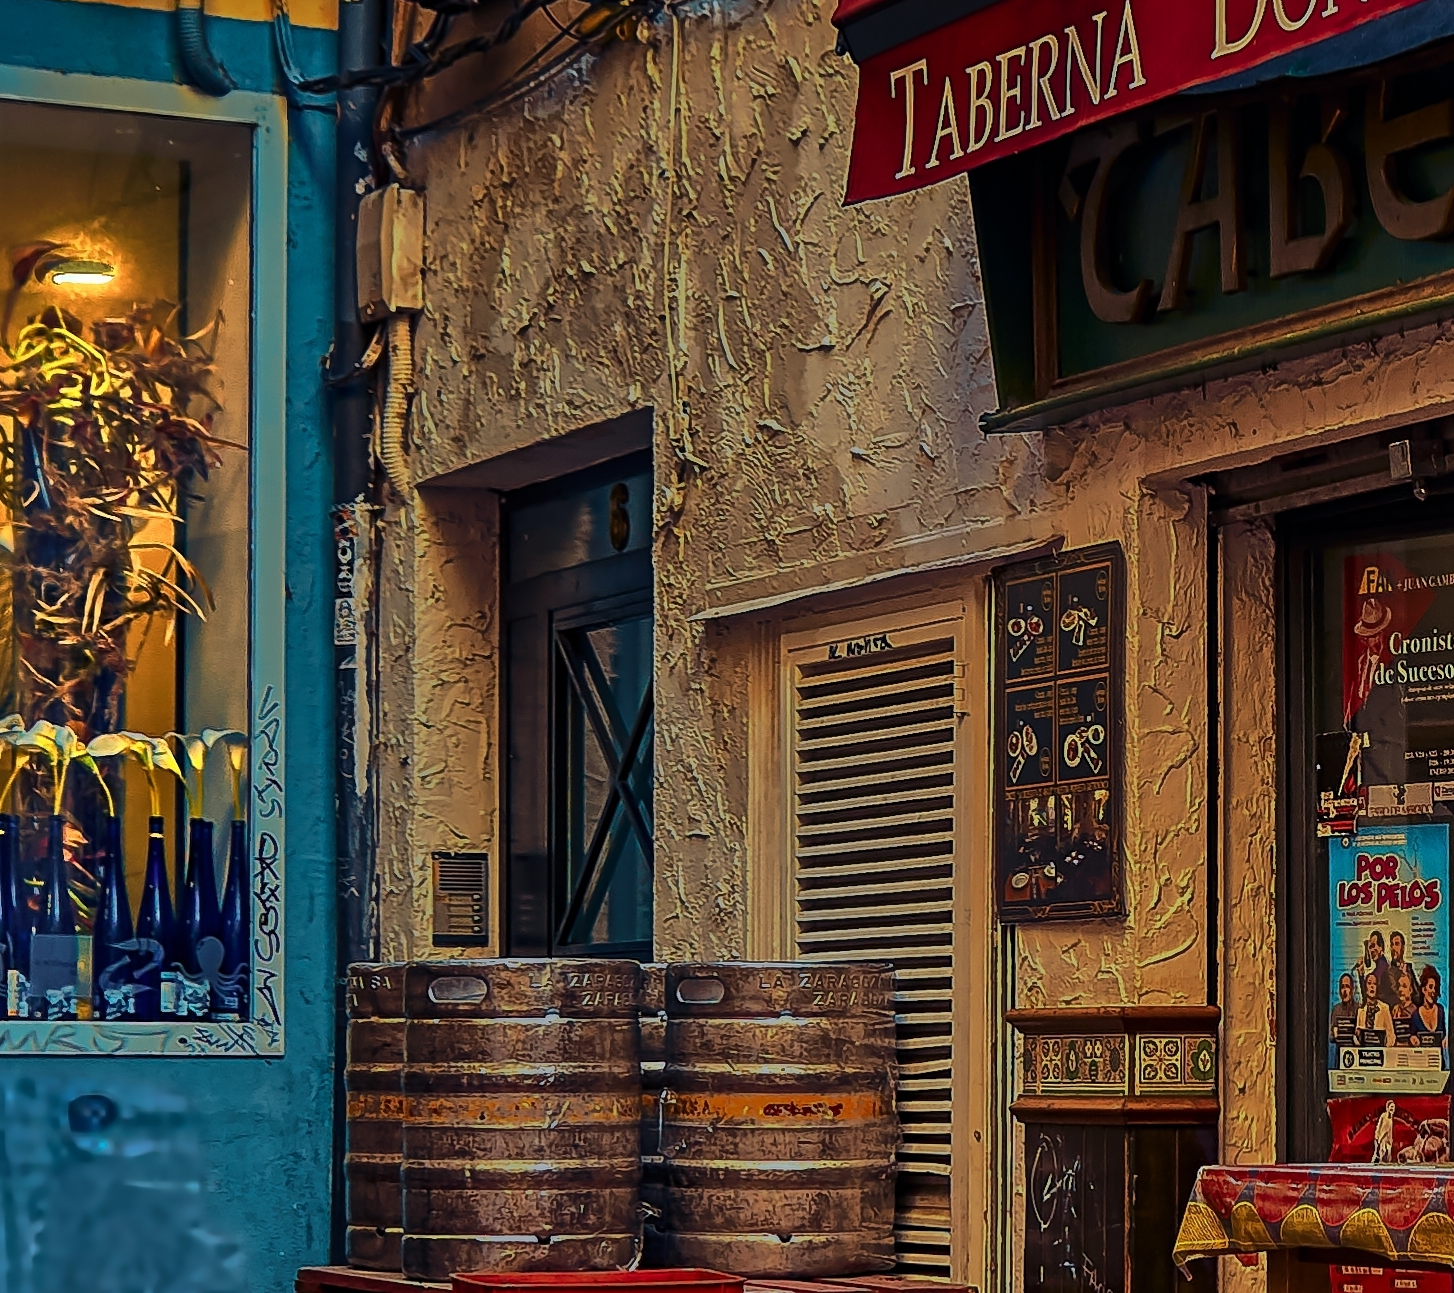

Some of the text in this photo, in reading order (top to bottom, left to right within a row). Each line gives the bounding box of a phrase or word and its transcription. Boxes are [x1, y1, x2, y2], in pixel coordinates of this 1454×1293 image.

[1374, 662, 1394, 685] de
[1356, 852, 1400, 882] POR
[1337, 878, 1442, 915] LOS PELOS
[759, 973, 783, 989] LA
